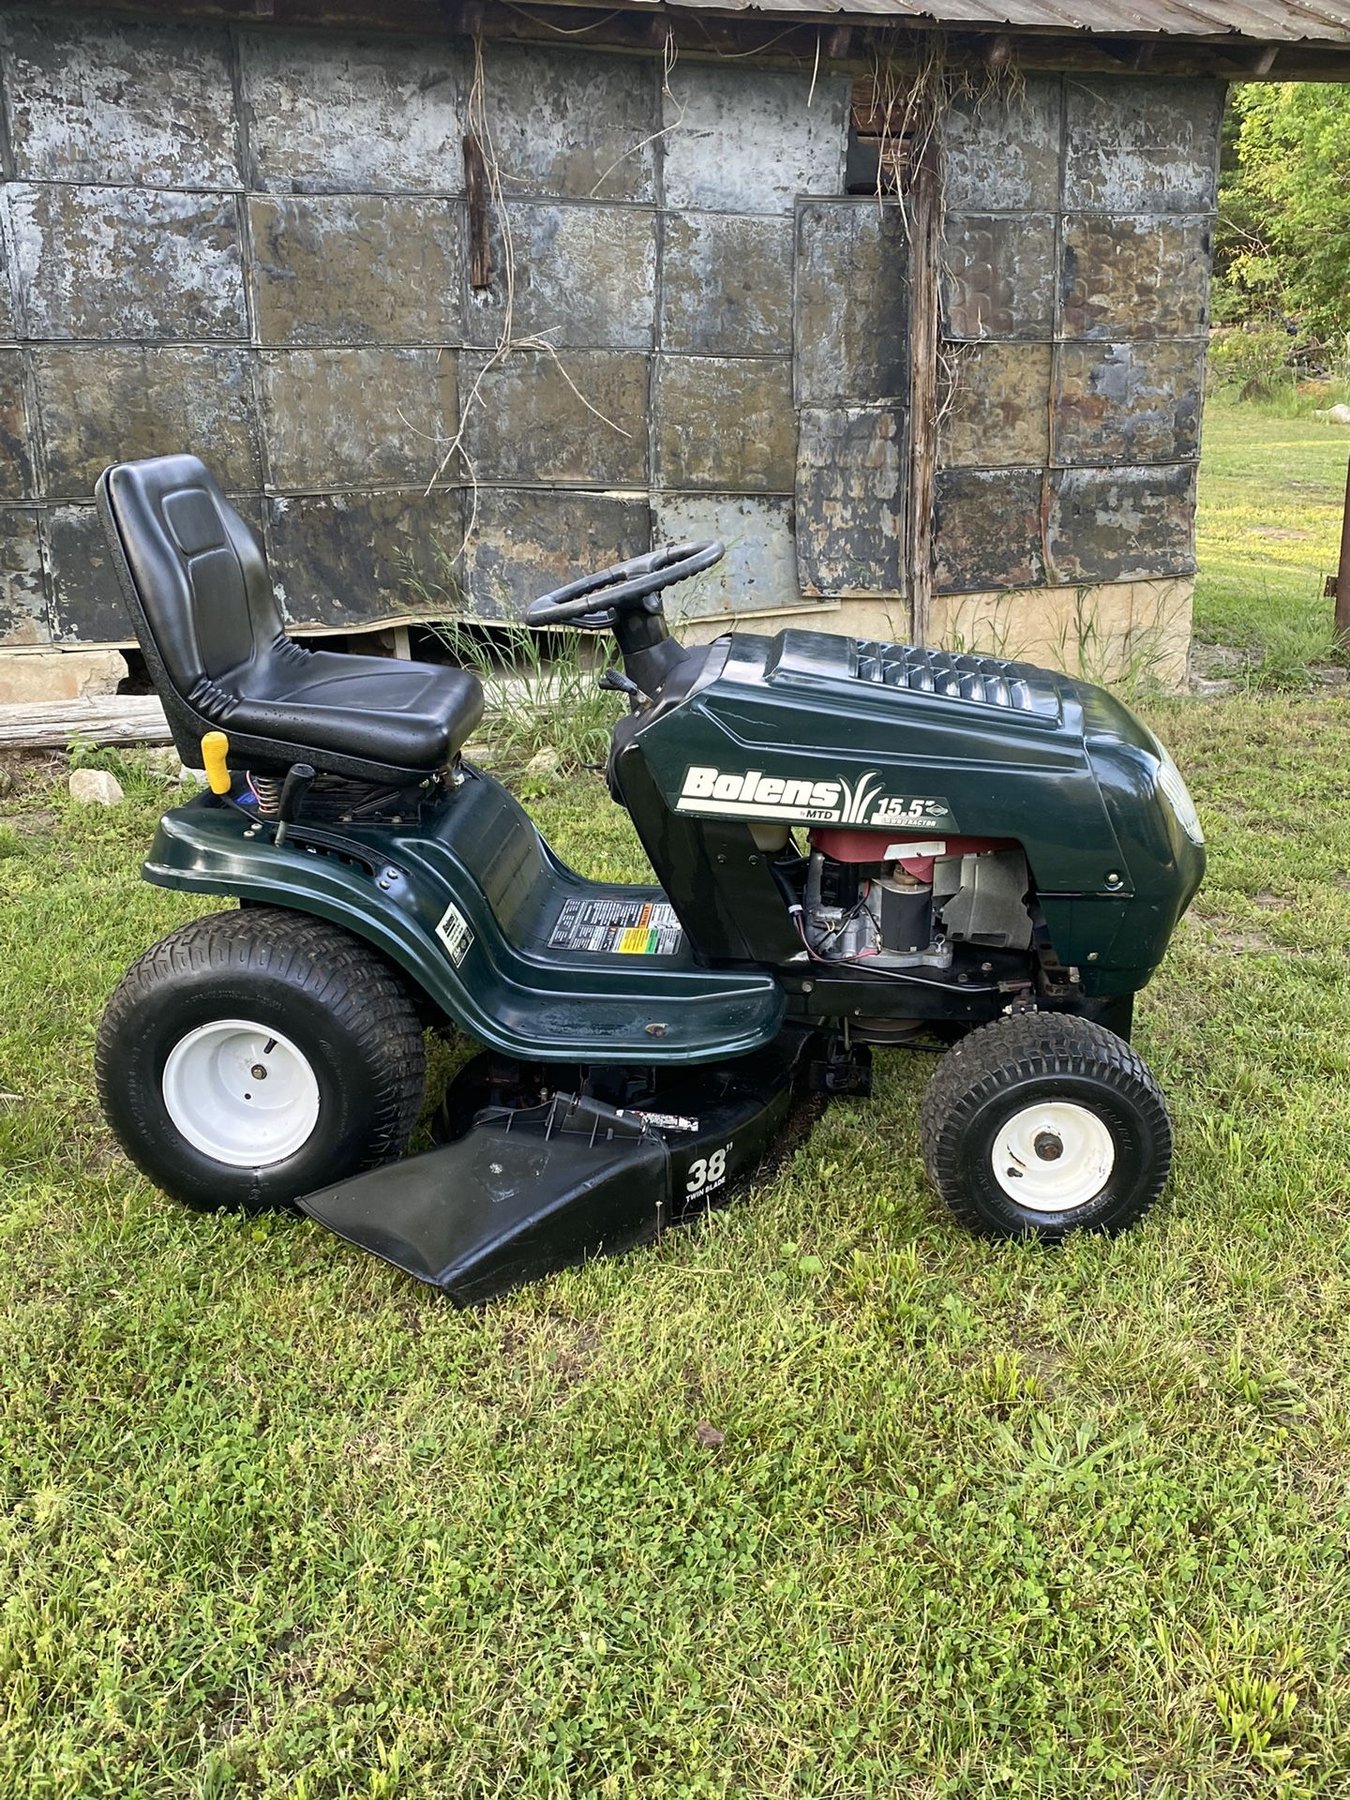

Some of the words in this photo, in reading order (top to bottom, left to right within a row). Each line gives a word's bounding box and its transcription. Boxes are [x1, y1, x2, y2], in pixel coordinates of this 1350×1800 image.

[681, 766, 842, 808] Bolens
[806, 809, 833, 820] MTD
[903, 819, 937, 827] TRACTOR
[685, 1188, 704, 1203] TWIN
[705, 1175, 726, 1193] BLADE
